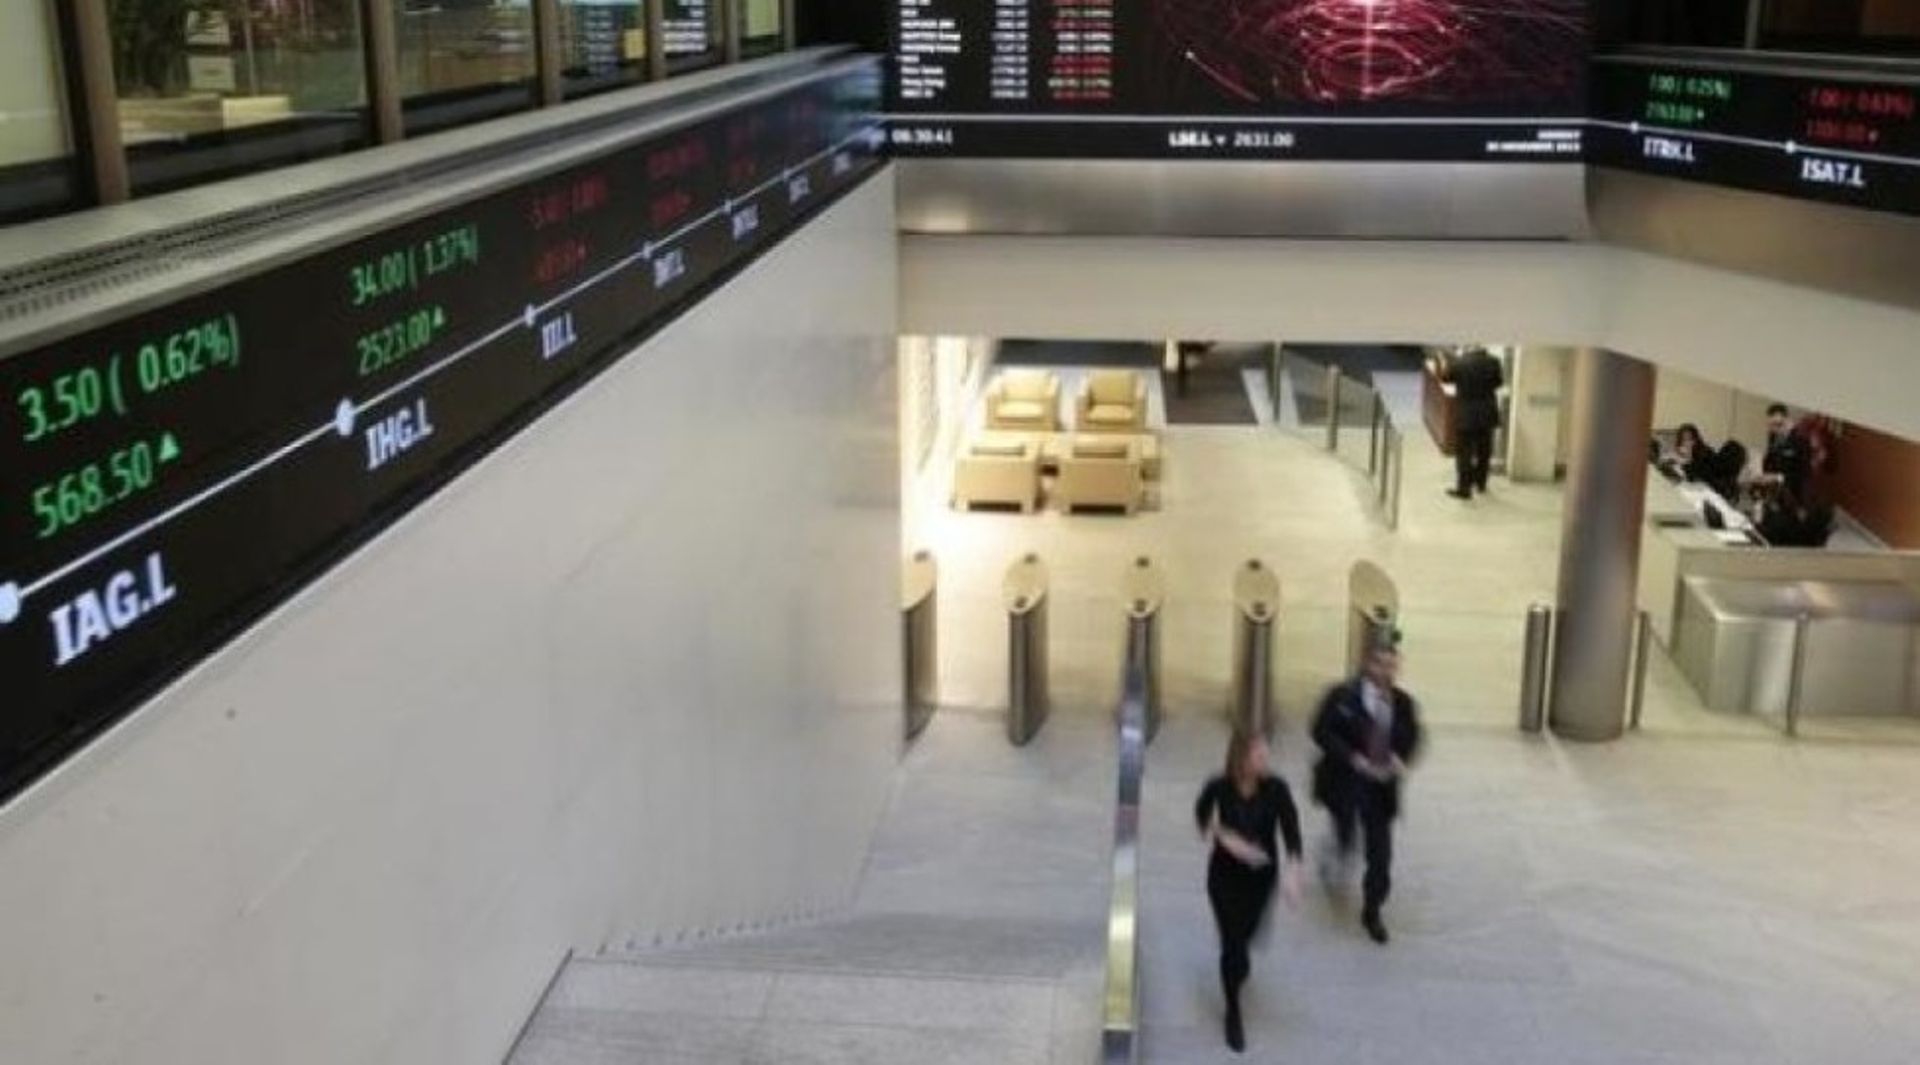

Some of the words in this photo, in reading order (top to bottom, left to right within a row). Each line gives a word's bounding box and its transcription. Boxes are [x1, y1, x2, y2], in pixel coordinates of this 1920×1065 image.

[1801, 157, 1866, 188] ISAT.L
[18, 366, 101, 442] 3.50
[364, 397, 435, 471] IHG.L
[32, 440, 153, 540] 568.50
[49, 551, 178, 667] IAG.L
